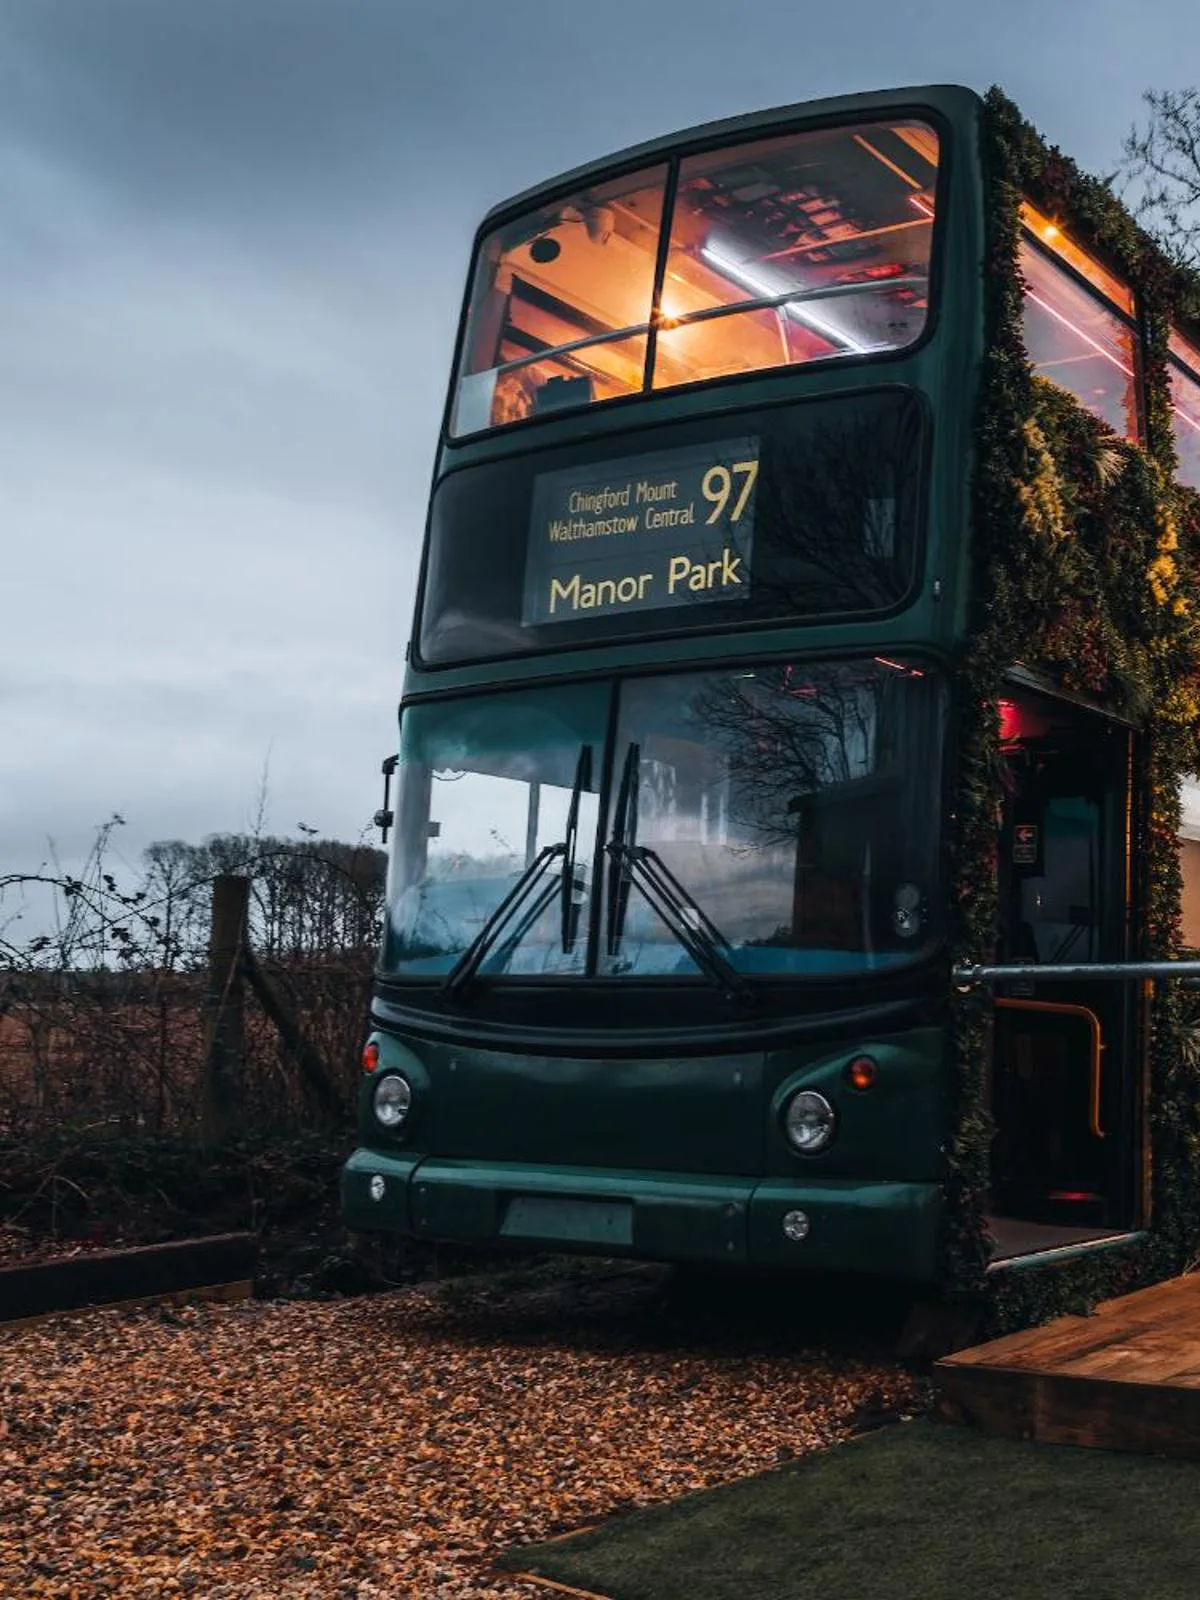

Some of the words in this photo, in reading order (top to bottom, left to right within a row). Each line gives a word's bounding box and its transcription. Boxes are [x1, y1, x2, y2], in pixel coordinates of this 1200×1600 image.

[569, 484, 630, 514] Chingford
[636, 481, 678, 502] Mount
[702, 460, 759, 525] 97
[549, 514, 638, 542] Walthamstow
[645, 503, 695, 530] Central
[550, 574, 653, 614] Manor
[668, 548, 742, 594] Park
